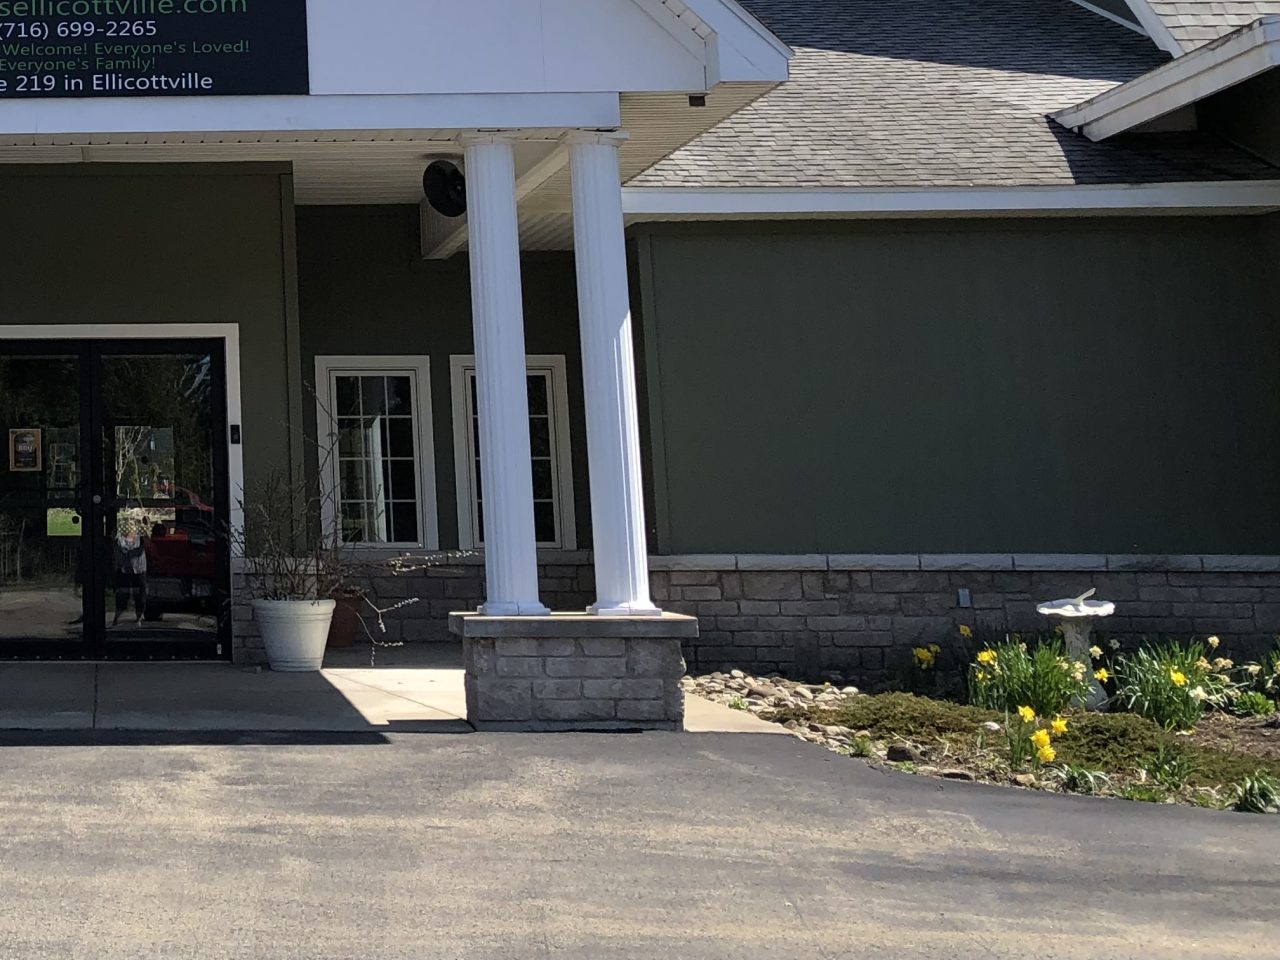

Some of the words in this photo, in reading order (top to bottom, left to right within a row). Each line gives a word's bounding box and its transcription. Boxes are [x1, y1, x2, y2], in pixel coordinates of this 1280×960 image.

[57, 20, 157, 38] 699-2265
[2, 41, 88, 56] Welcome!
[94, 41, 186, 58] Everyone's
[192, 40, 250, 54] Loved!
[96, 56, 155, 72] Family!
[15, 75, 56, 91] 219
[64, 74, 83, 91] in
[92, 72, 213, 91] Ellicottville
